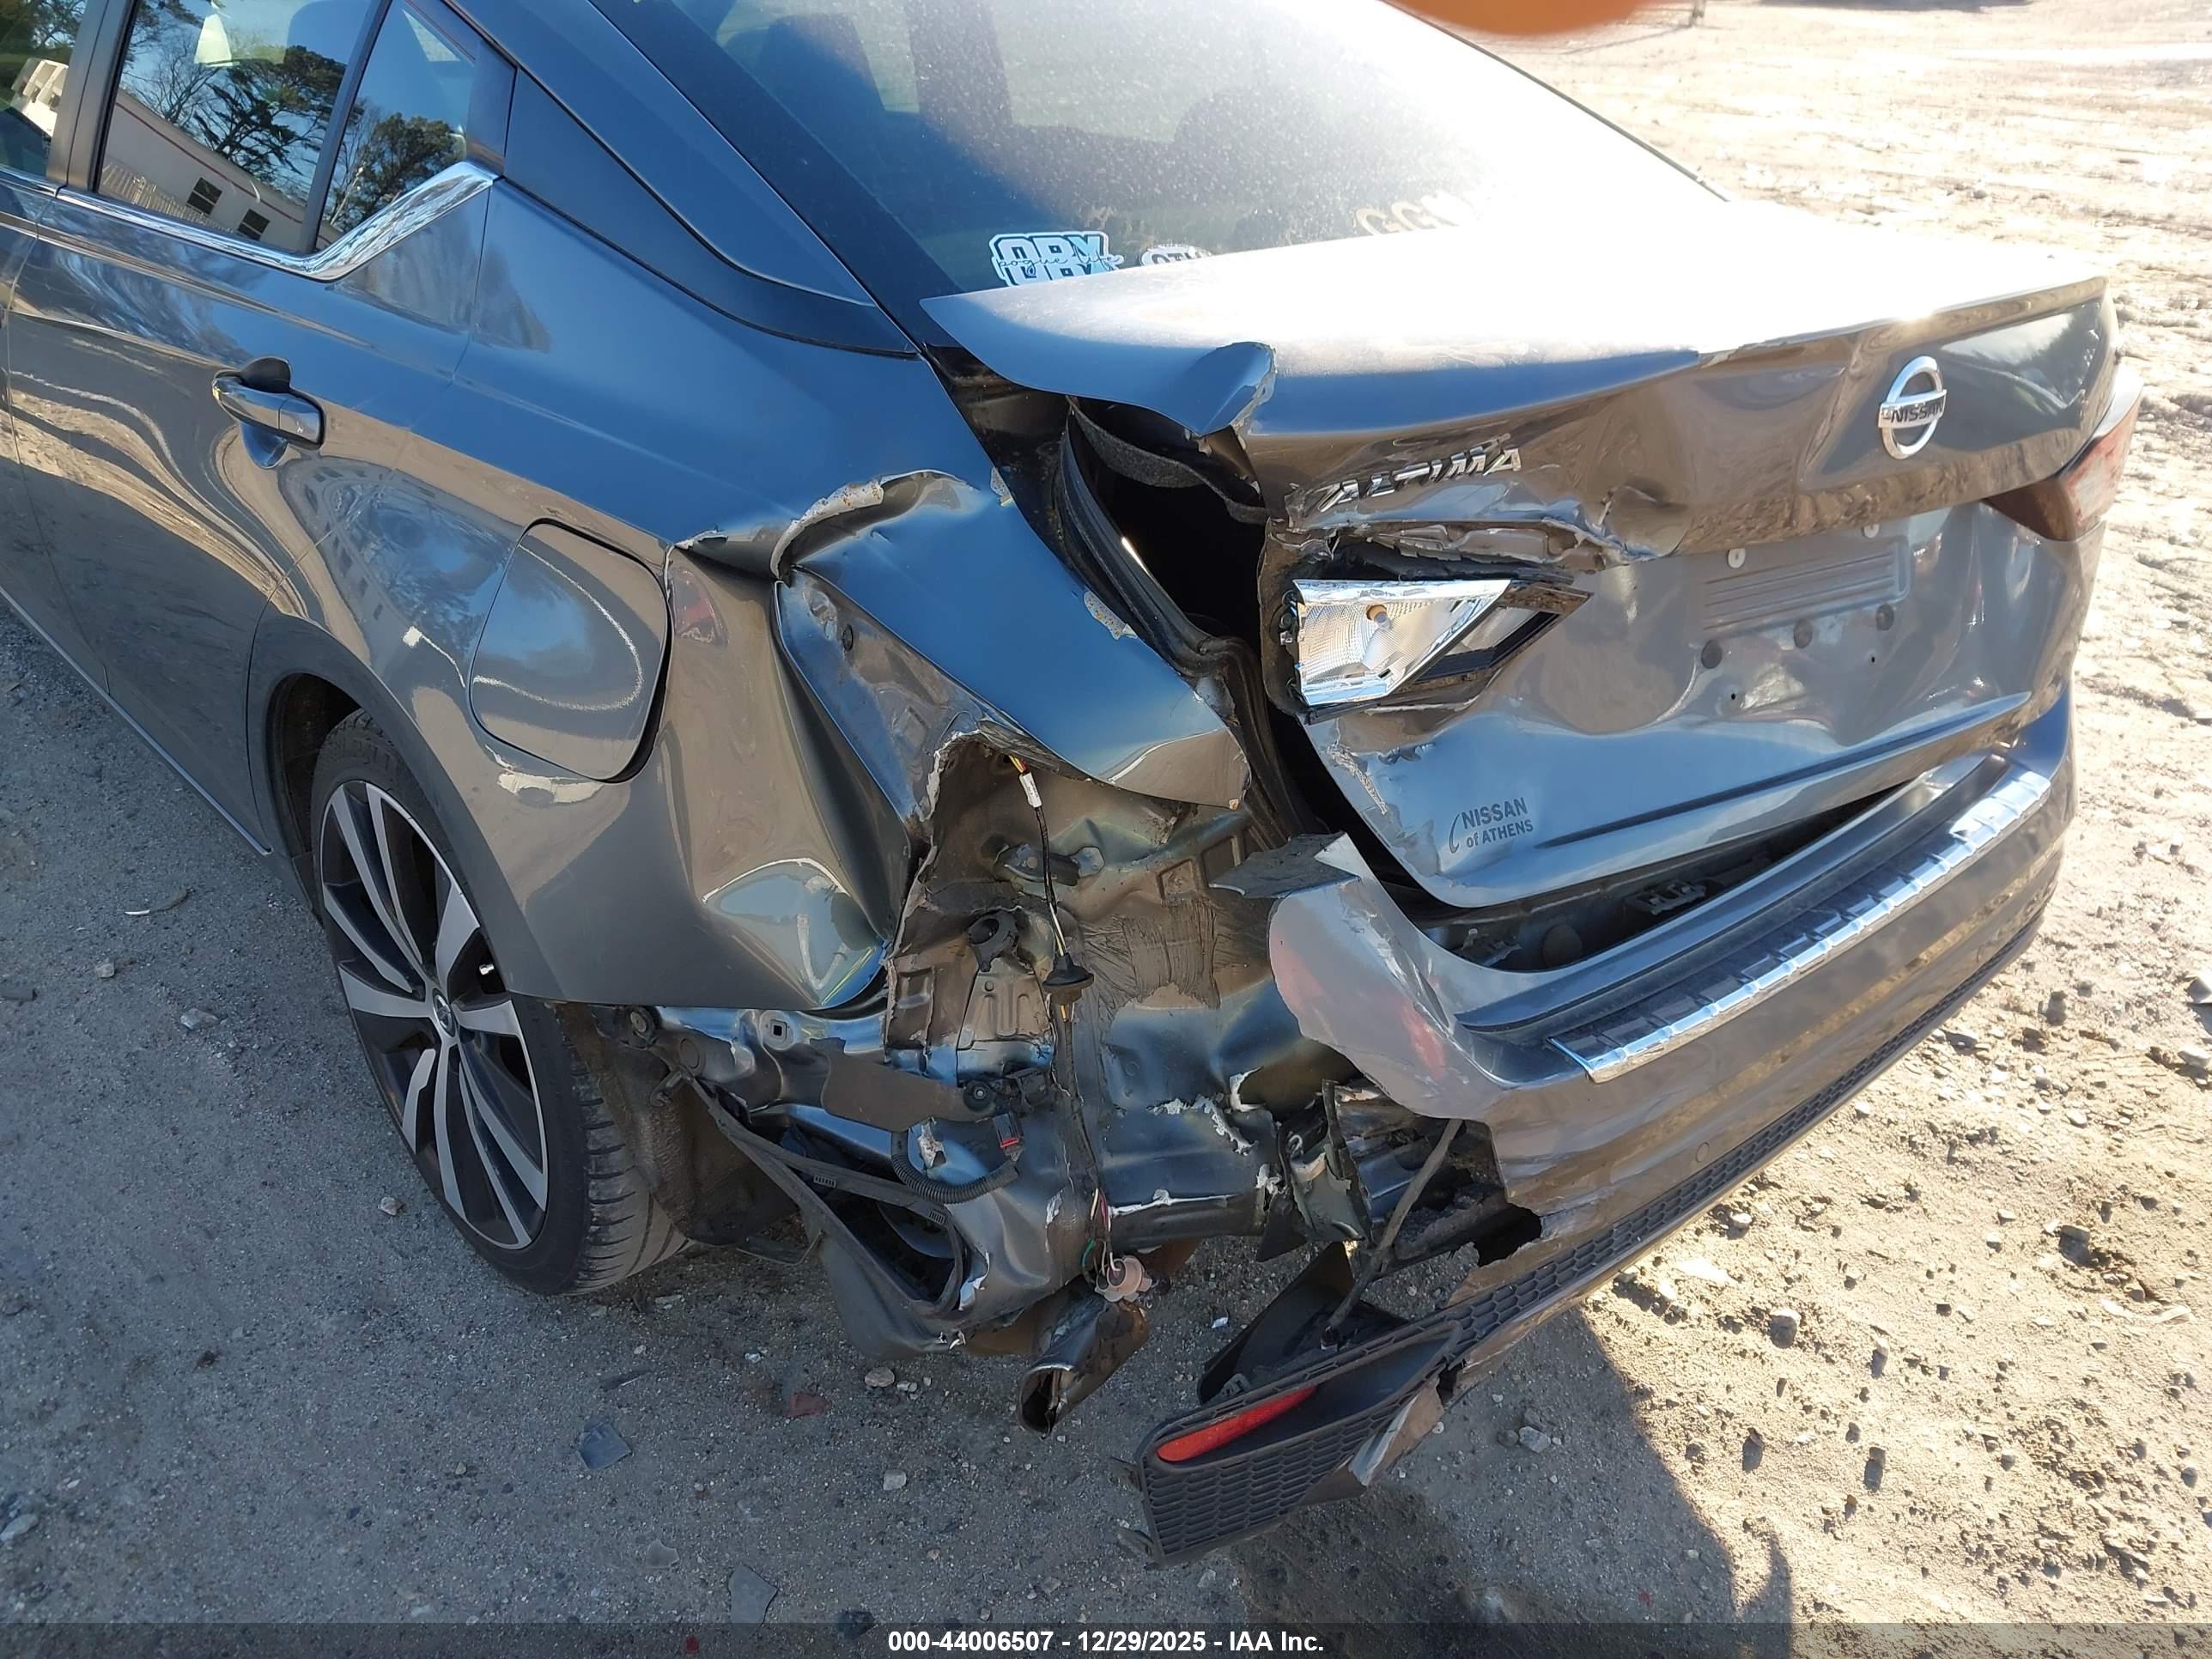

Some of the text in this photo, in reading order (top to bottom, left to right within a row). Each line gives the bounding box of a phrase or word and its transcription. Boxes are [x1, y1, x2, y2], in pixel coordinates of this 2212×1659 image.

[1891, 403, 1944, 424] NISSAN
[1318, 446, 1522, 513] ALTIMA
[1462, 797, 1528, 830] NISSAN
[1466, 818, 1534, 848] of ATHENS
